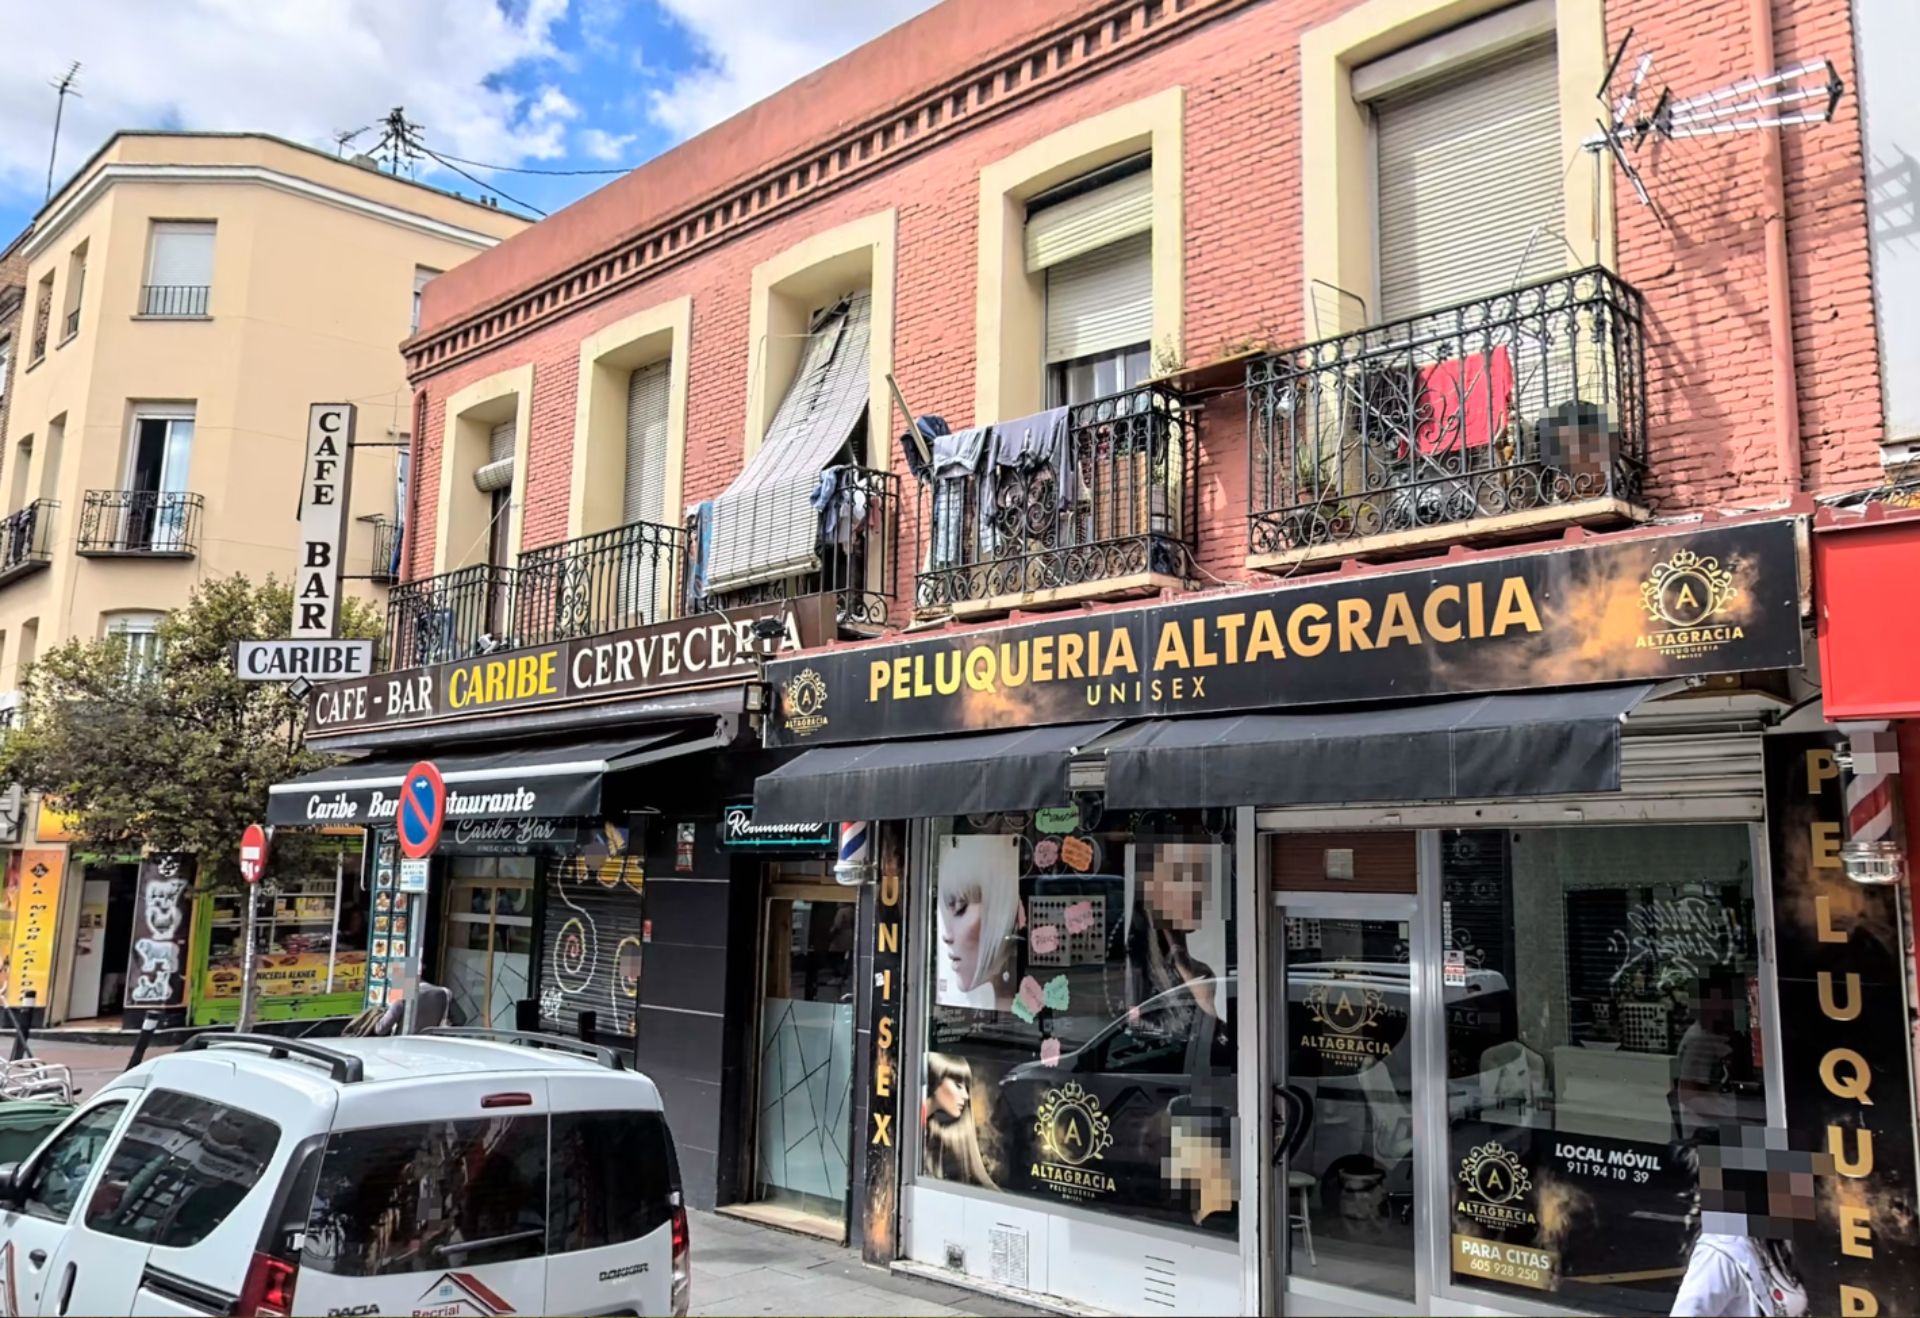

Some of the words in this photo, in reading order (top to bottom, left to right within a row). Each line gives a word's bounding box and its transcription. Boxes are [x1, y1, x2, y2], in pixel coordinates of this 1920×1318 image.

[312, 412, 341, 505] CAFE
[298, 541, 331, 629] BAR
[1675, 583, 1699, 610] A
[869, 626, 1138, 702] PELUQUERIA
[1153, 576, 1543, 671] ALTAGRACIA
[1636, 627, 1744, 648] ALTAGRACIA
[248, 646, 362, 674] CARIBE
[315, 686, 367, 725] CAFE
[386, 676, 433, 716] BAR
[449, 651, 558, 708] CARIBE
[802, 688, 812, 705] A
[1086, 675, 1206, 706] UNISEX
[307, 792, 357, 819] Caribe
[367, 791, 400, 817] Bar
[455, 814, 514, 844] Caribe
[871, 876, 899, 1148] UNISEX
[1335, 991, 1354, 1016] A
[1301, 1035, 1392, 1055] ALTAGRACIA
[1063, 1117, 1083, 1147] A
[1555, 1143, 1605, 1163] LOCAL
[1607, 1149, 1662, 1171] MÓVIL
[1030, 1163, 1116, 1191] ALTAGRACIA
[1486, 1169, 1504, 1190] A
[1567, 1161, 1588, 1175] 911
[1592, 1164, 1608, 1178] 94
[1612, 1167, 1627, 1180] 10
[1632, 1170, 1650, 1183] 39
[1457, 1201, 1536, 1224] ALTAGRACIA
[1461, 1240, 1502, 1261] PARA
[1505, 1249, 1550, 1270] CITAS
[1470, 1257, 1491, 1272] 605
[1493, 1263, 1514, 1277] 928
[1518, 1267, 1539, 1281] 250
